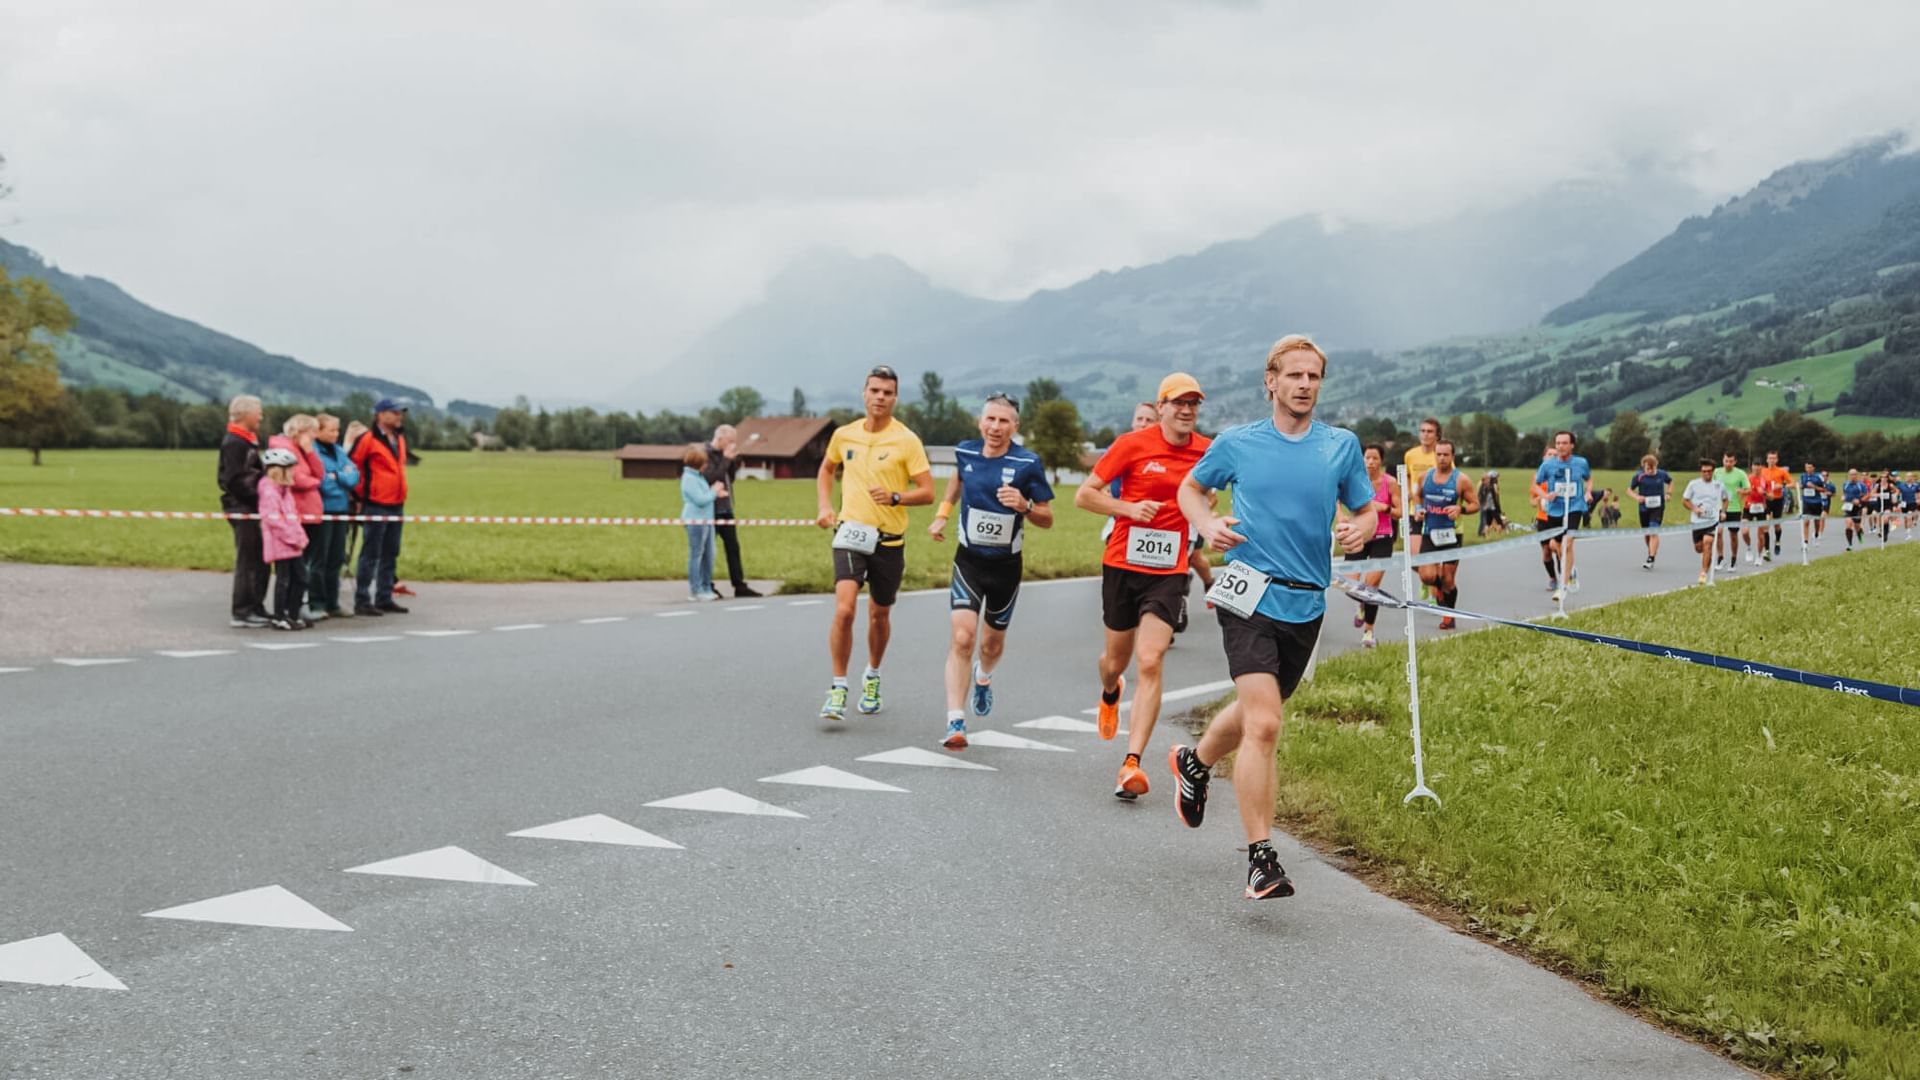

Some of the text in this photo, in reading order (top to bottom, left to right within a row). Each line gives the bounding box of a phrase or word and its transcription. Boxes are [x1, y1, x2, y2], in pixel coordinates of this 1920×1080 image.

[844, 529, 868, 543] 293
[976, 521, 1003, 536] 692
[1135, 539, 1173, 556] 2014
